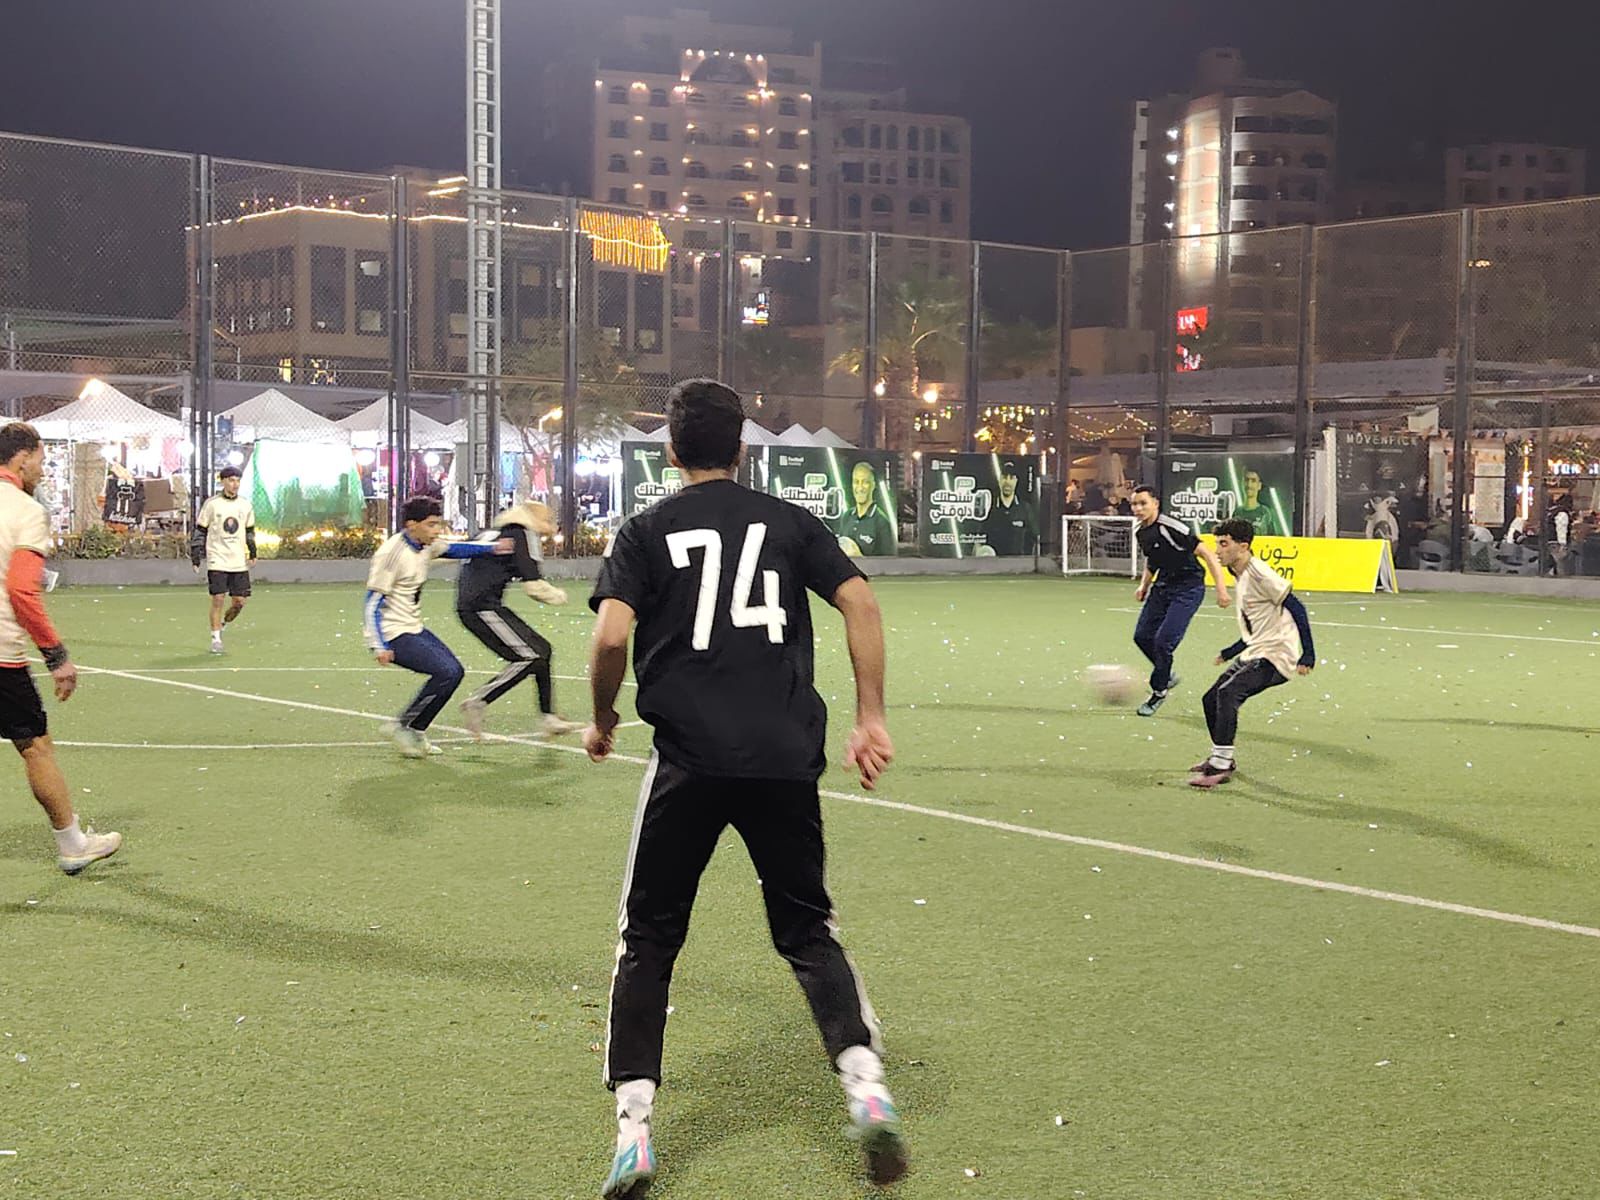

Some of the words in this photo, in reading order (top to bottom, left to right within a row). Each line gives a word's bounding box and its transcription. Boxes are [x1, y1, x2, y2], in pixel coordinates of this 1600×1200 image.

[932, 492, 973, 503] شنطتك
[1173, 492, 1215, 505] شنطتك
[1260, 544, 1299, 565] نون
[665, 522, 788, 651] 74
